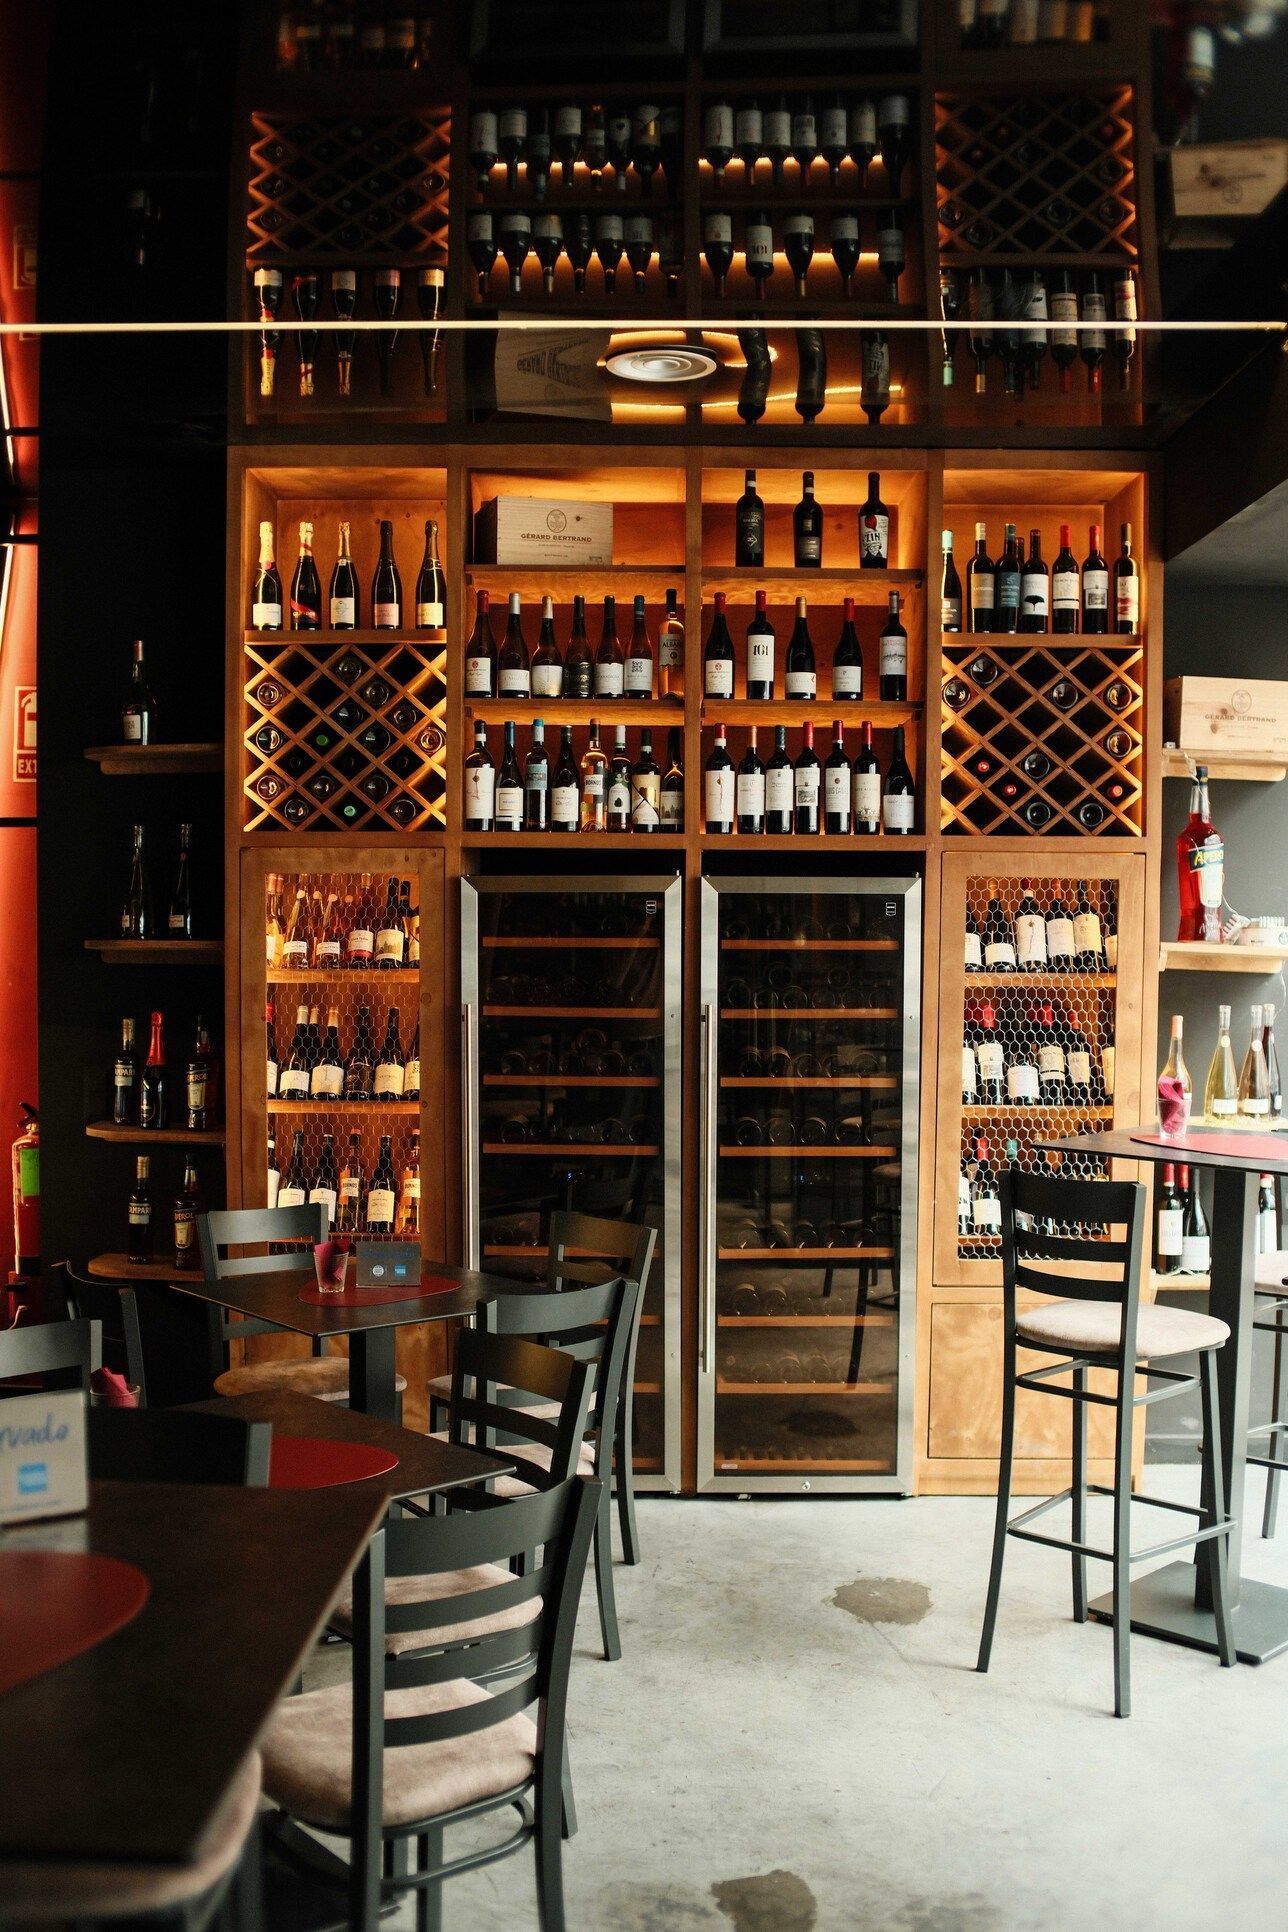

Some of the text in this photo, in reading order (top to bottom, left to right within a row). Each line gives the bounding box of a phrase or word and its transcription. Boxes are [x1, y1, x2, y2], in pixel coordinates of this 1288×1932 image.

[520, 532, 592, 543] GÉRARD BERTRAND
[1204, 713, 1277, 723] GÉRARD BERTRAND
